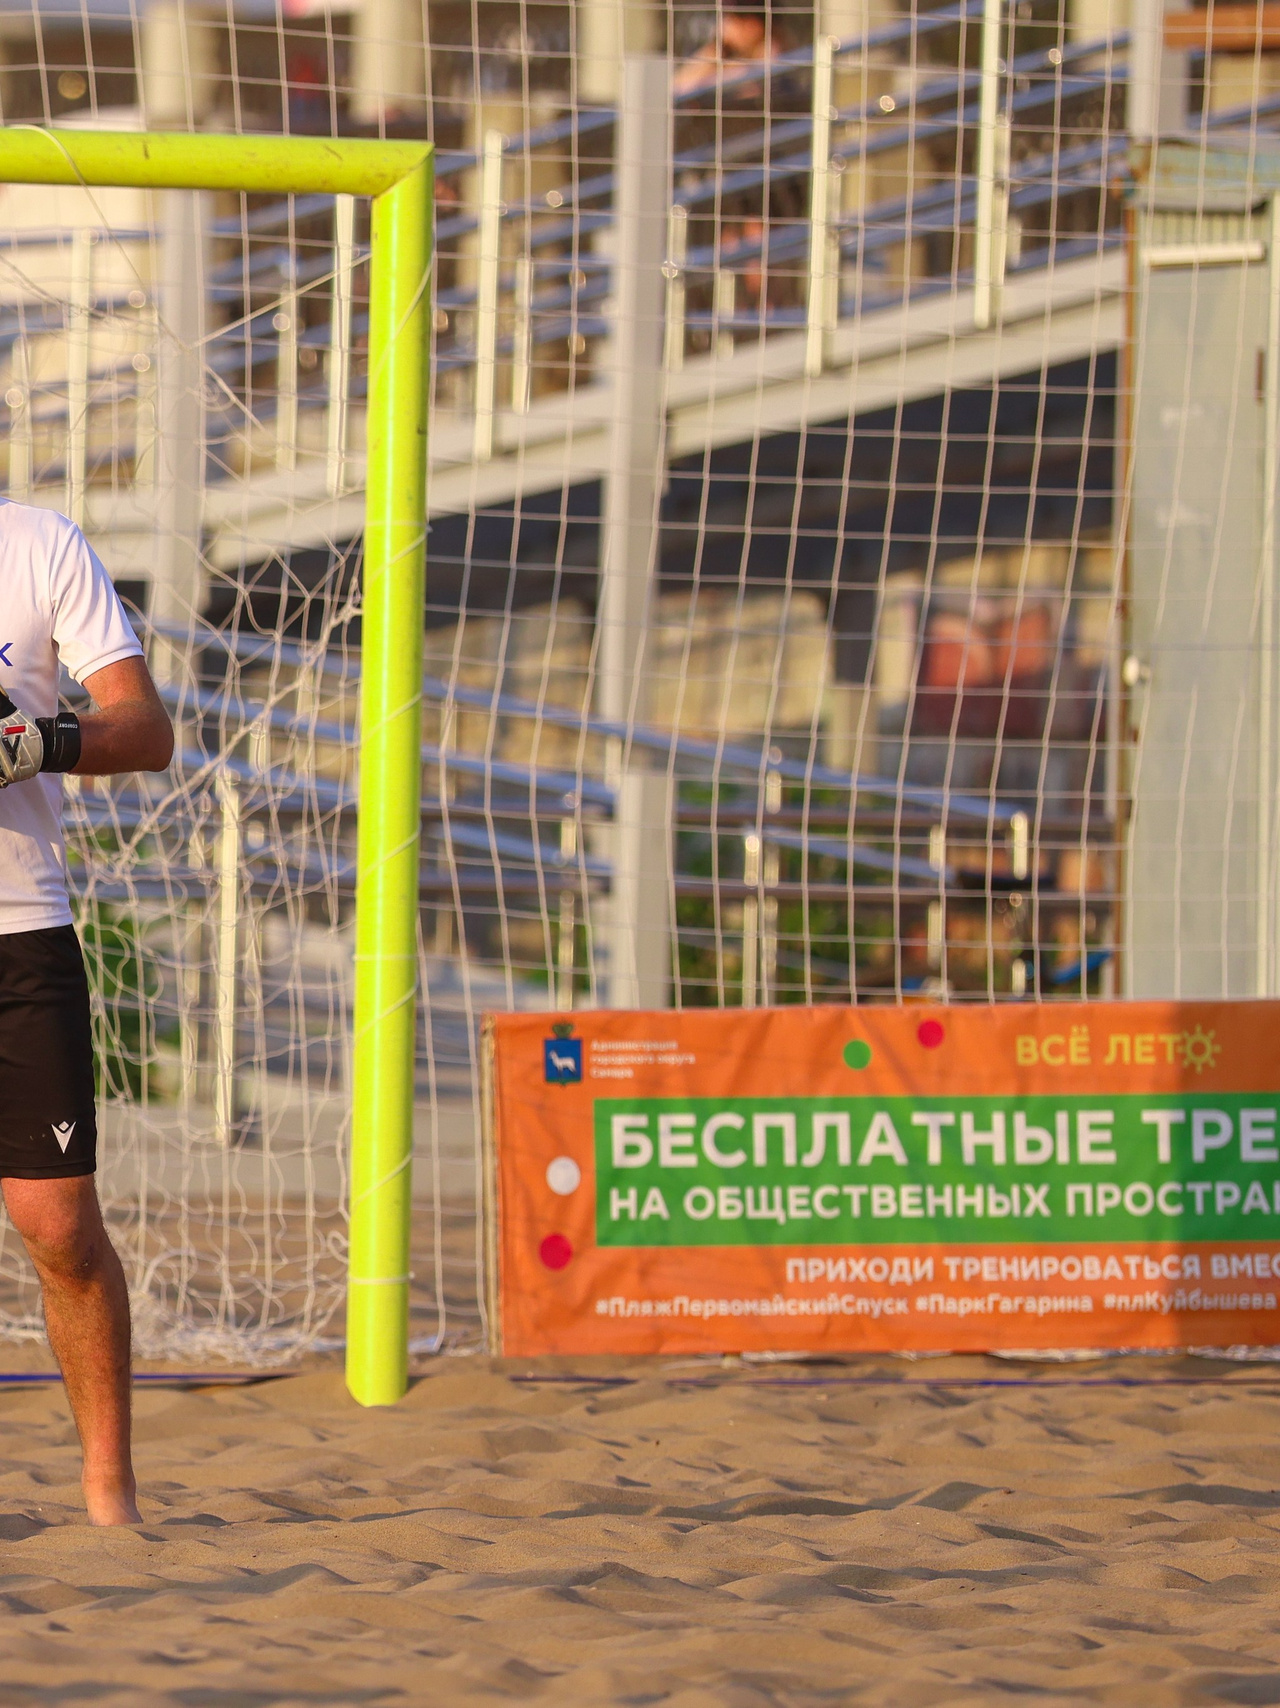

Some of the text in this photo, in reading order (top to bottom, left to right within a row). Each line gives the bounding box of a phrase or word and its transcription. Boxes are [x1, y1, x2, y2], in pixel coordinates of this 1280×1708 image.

[1016, 1024, 1091, 1066] ВСЁ
[611, 1108, 1279, 1168] БЕСПЛАТНЫЕ ТРЕ
[610, 1180, 1280, 1225] НА ОБЩЕСТВЕННЫХ ПРОСТРА
[786, 1256, 934, 1285] ПРИХОДИ
[943, 1253, 1202, 1282] ТРЕНИРОВАТЬСЯ
[595, 1287, 1278, 1319] #ПляжПервомайскийСпуск #ПаркГагарина #плКуйбышева
